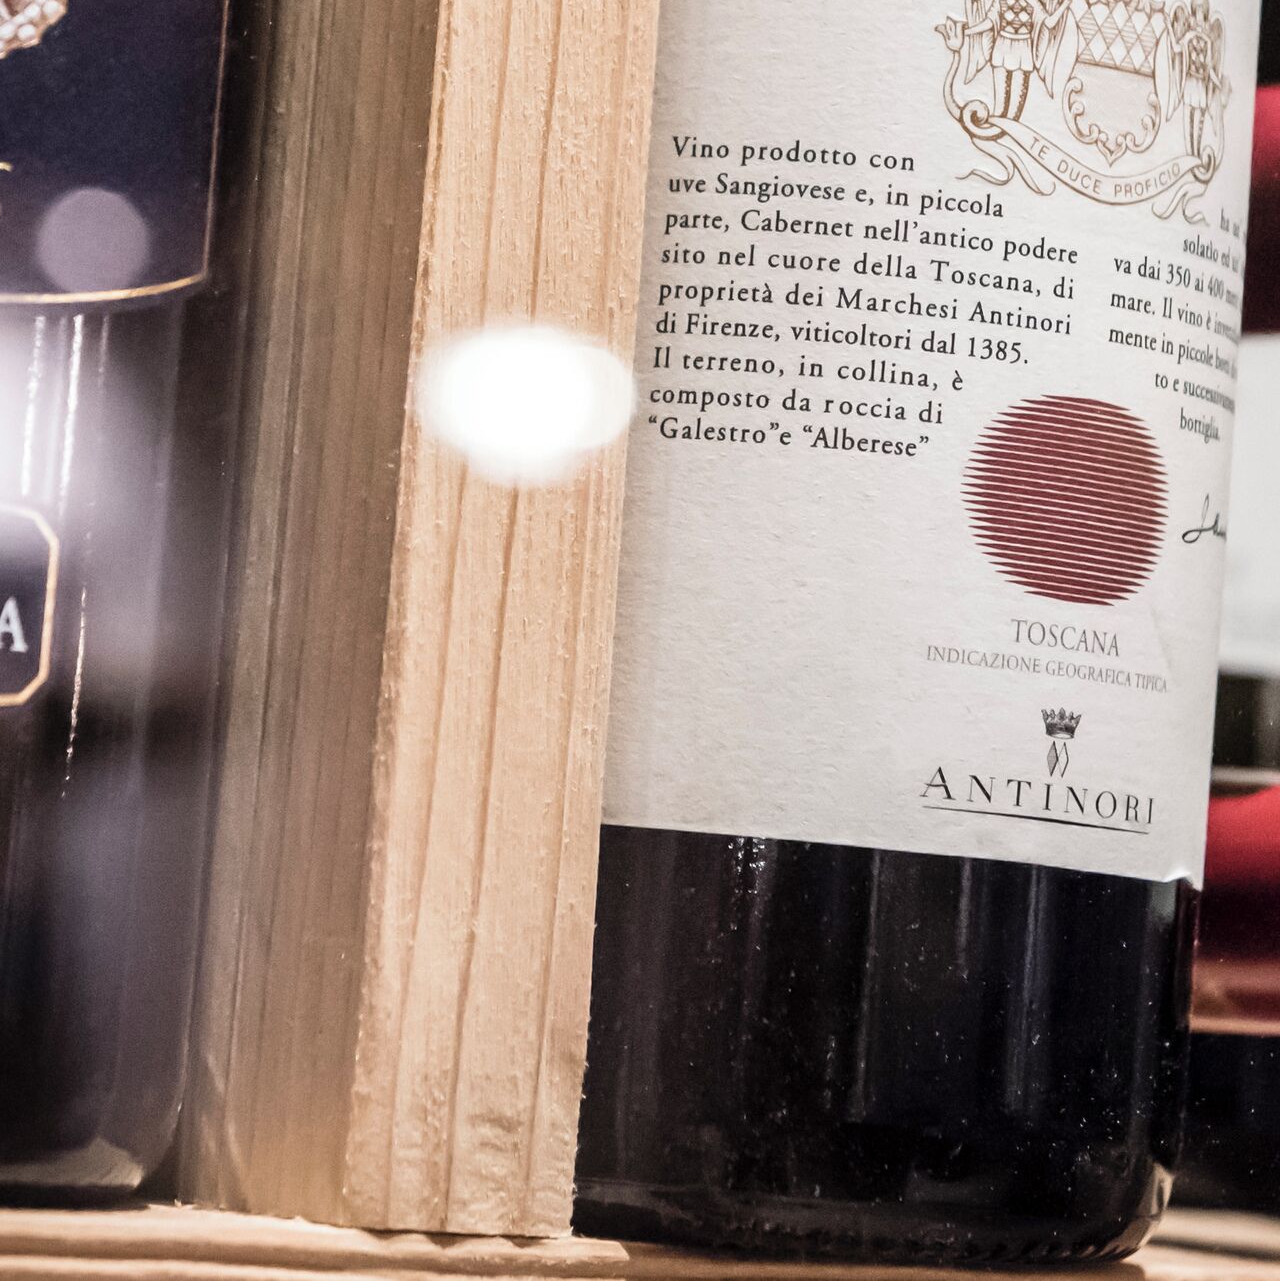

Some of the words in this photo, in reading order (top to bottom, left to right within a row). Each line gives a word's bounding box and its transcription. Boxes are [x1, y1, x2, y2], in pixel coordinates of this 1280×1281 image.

[672, 136, 729, 159] Vino
[741, 140, 858, 166] prodotto
[869, 152, 915, 172] con
[1029, 136, 1048, 159] TE
[1057, 160, 1101, 195] DUCE
[1114, 163, 1181, 198] PROFICIO
[668, 176, 707, 194] uve
[714, 174, 846, 204] Sangiovese
[855, 188, 874, 207] e,
[886, 184, 909, 208] in
[919, 189, 1005, 218] piccola
[663, 211, 730, 236] parte,
[740, 209, 854, 238] Cabernet
[1003, 238, 1079, 266] podere
[661, 245, 706, 265] sito
[718, 244, 755, 267] nel
[767, 250, 841, 272] cuore
[853, 252, 918, 279] della
[929, 259, 1042, 298] Toscana,
[1052, 275, 1075, 301] di
[1114, 257, 1131, 275] va
[1138, 255, 1161, 281] dai
[1166, 263, 1191, 289] 350
[1194, 273, 1204, 294] ai
[1208, 274, 1225, 300] 400
[658, 281, 774, 307] proprietà
[785, 282, 824, 308] dei
[835, 287, 959, 321] Marchesi
[968, 300, 1072, 336] Antinori
[1110, 293, 1156, 316] mare.
[1162, 296, 1173, 320] Il
[1178, 303, 1203, 328] vino
[655, 311, 677, 335] di
[685, 313, 781, 342] Firenze,
[791, 319, 912, 351] viticoltori
[920, 329, 956, 356] dal
[968, 337, 1030, 366] 1385.
[1108, 328, 1157, 351] mente
[1161, 332, 1174, 356] in
[1177, 339, 1214, 367] piccole
[652, 346, 672, 369] Il
[682, 353, 785, 378] terreno,
[798, 355, 824, 379] in
[837, 357, 939, 391] collina,
[951, 370, 965, 392] è
[1155, 372, 1169, 390] to
[1173, 378, 1180, 392] e
[649, 387, 771, 412] composto
[781, 387, 811, 413] da
[824, 393, 907, 421] roccia
[919, 401, 944, 425] di
[1011, 618, 1121, 658] TOSCANA
[926, 644, 1041, 675] INDICAZIONE
[1045, 660, 1132, 689] GEOGRAFICA
[1135, 672, 1168, 694] TIPICA
[920, 765, 1155, 825] ANTINORI
